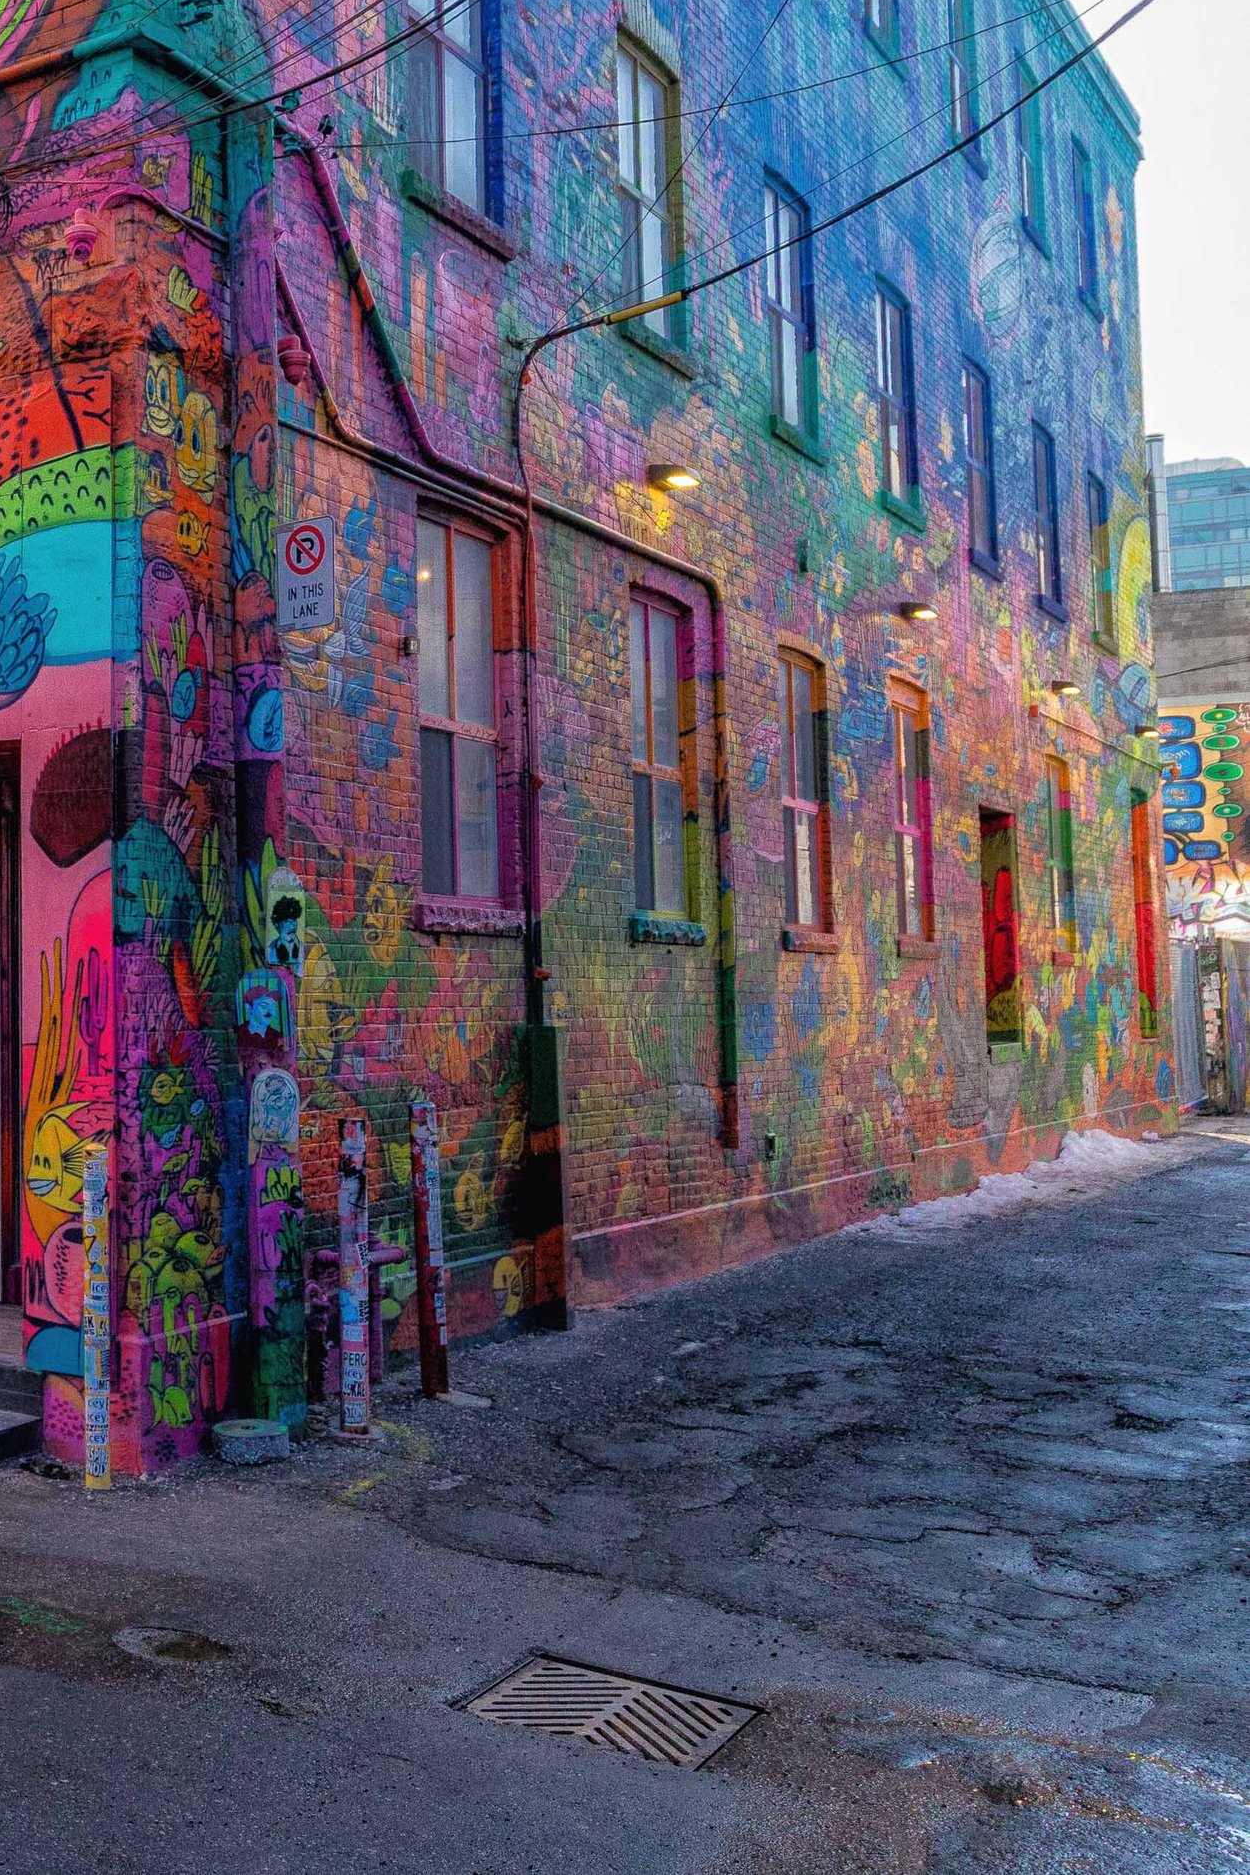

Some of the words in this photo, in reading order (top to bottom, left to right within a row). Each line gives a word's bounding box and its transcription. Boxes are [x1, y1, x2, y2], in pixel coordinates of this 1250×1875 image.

[287, 587, 298, 602] IN
[301, 582, 325, 599] THIS
[292, 602, 320, 619] LANE
